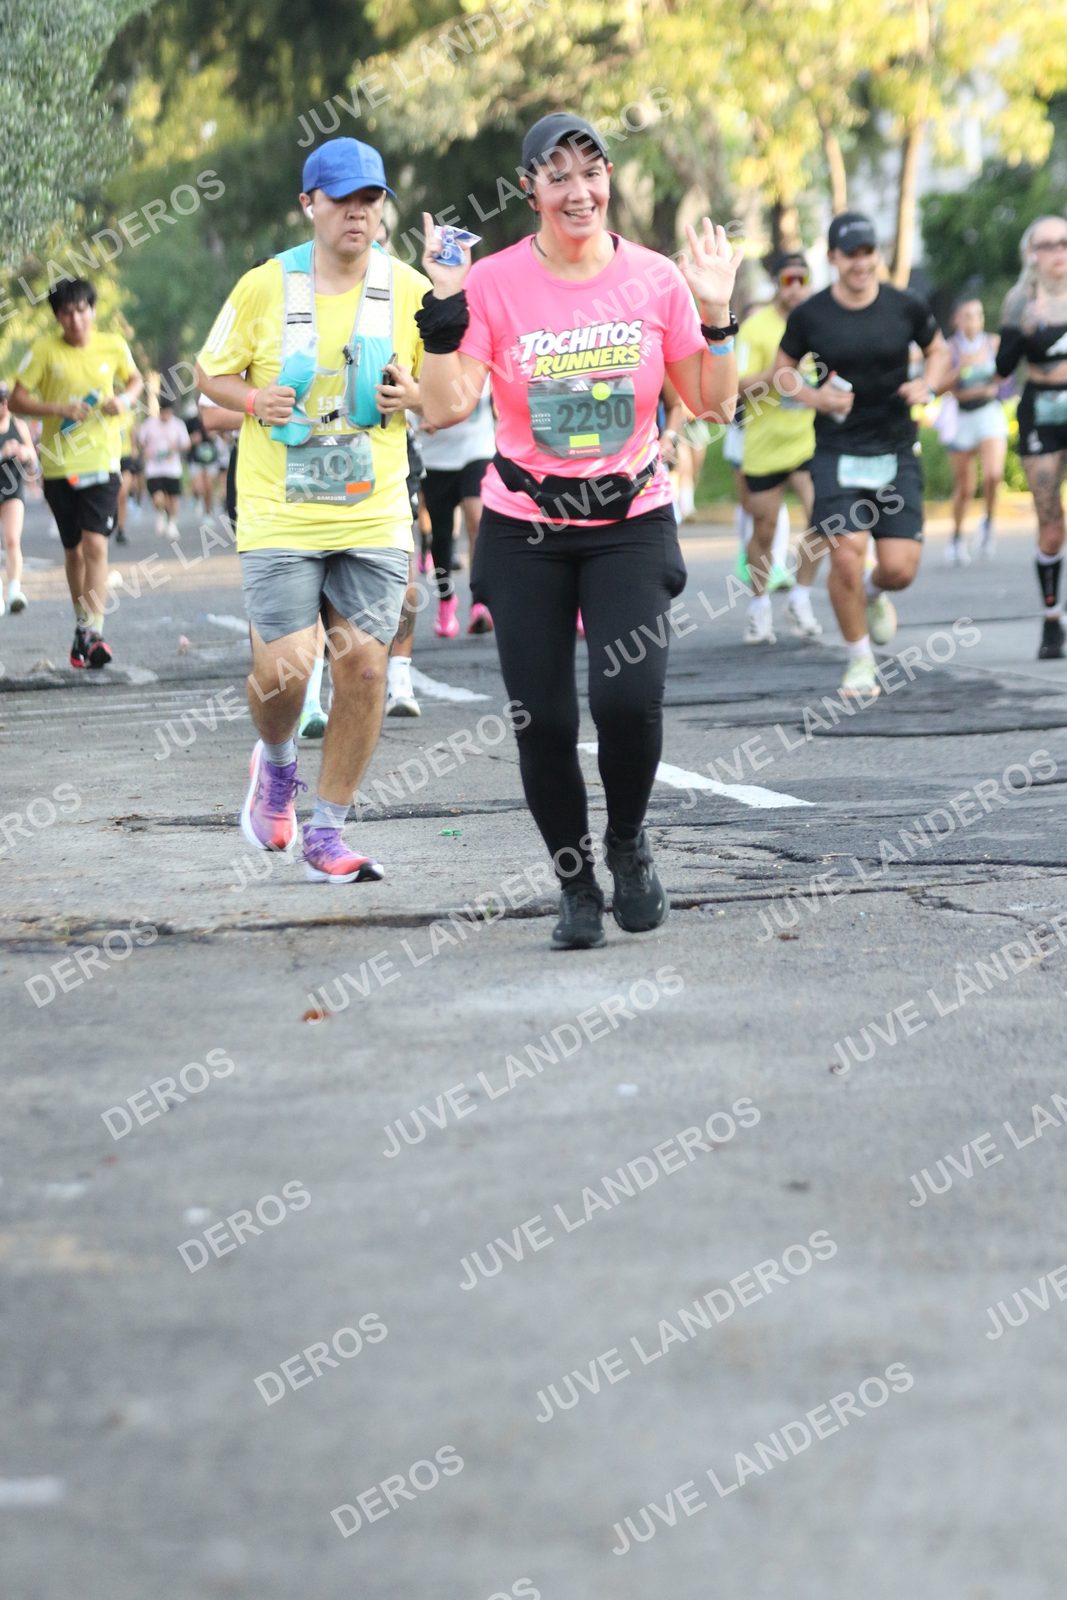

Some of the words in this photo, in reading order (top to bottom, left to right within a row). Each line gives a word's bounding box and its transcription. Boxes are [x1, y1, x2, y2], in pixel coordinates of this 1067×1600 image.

[519, 320, 643, 364] TOCHITOS
[532, 344, 641, 377] RUNNERS
[557, 398, 632, 433] 2290
